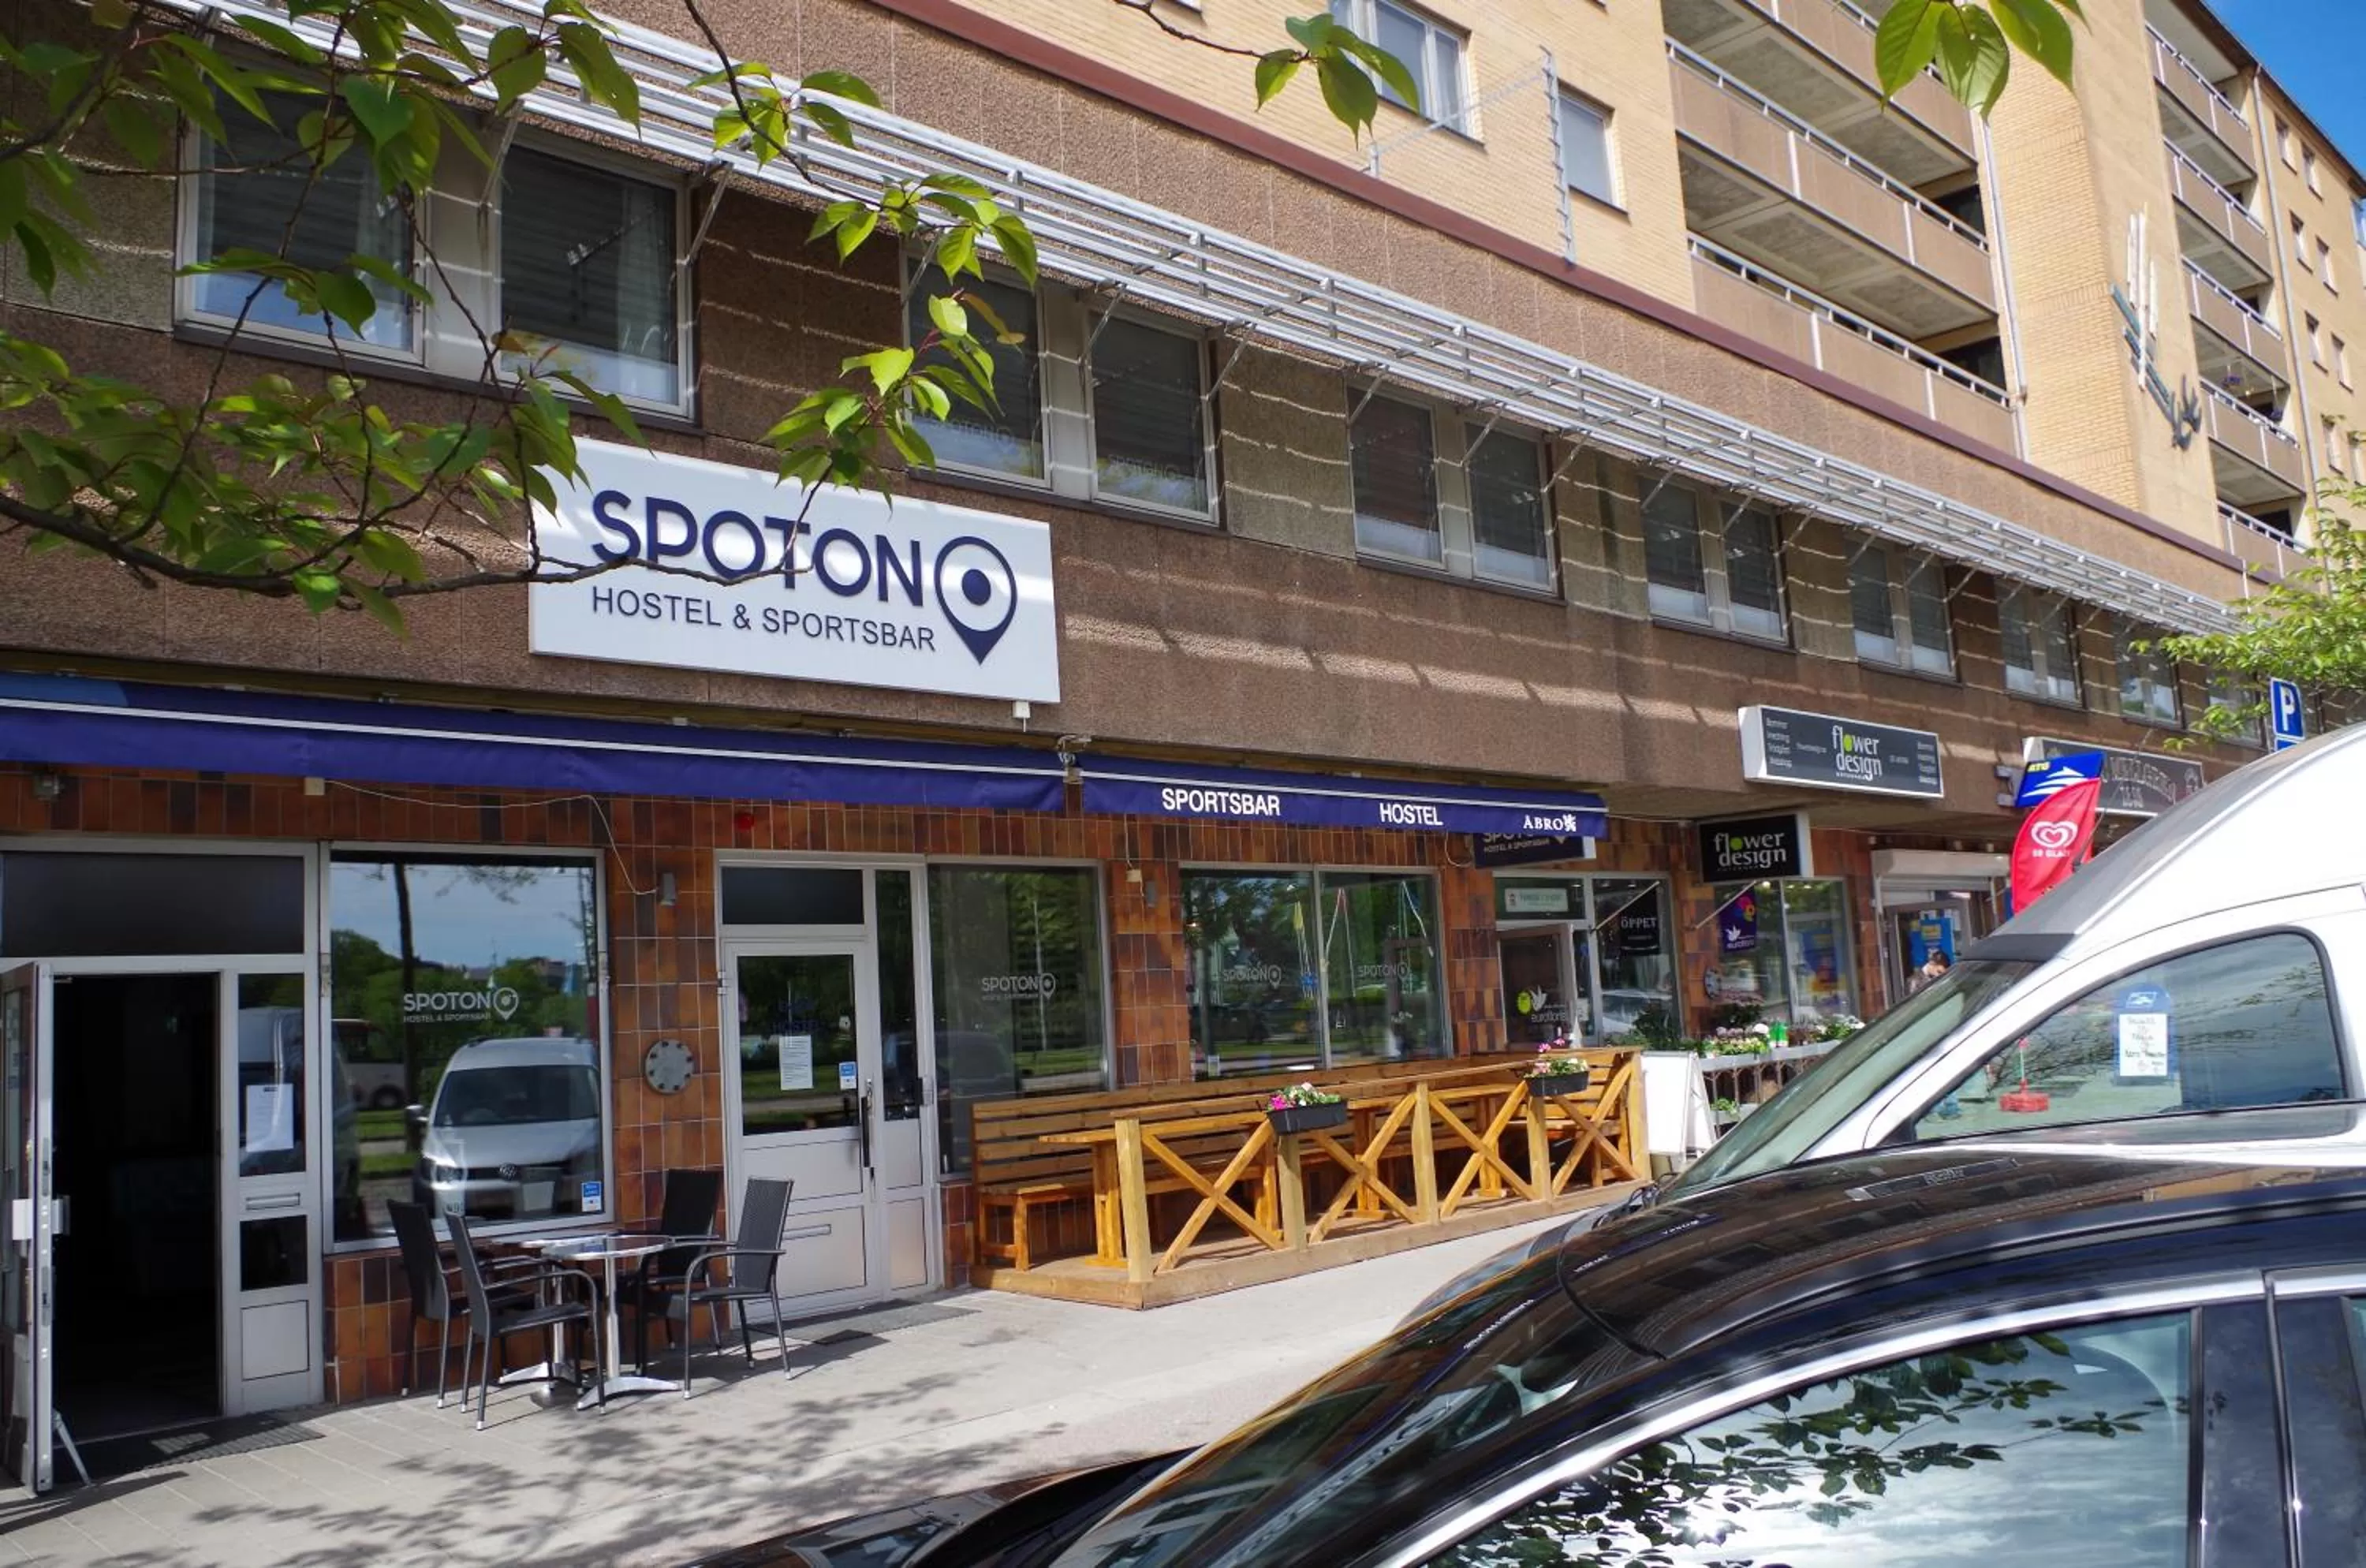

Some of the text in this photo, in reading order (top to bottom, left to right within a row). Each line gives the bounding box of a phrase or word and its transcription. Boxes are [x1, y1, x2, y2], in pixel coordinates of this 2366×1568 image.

[592, 490, 924, 607] SPOTON
[592, 586, 935, 651] HOSTEL & SPORTSBAR
[2280, 685, 2296, 732] P
[1832, 725, 1879, 755] flower
[1836, 752, 1883, 781] design
[1161, 787, 1281, 816] SPORTSBAR
[1379, 802, 1444, 827] HOSTEL
[1714, 832, 1786, 853] flower
[1718, 847, 1787, 868] design
[980, 976, 1039, 991] SPOTON
[403, 991, 491, 1012] SPOTON
